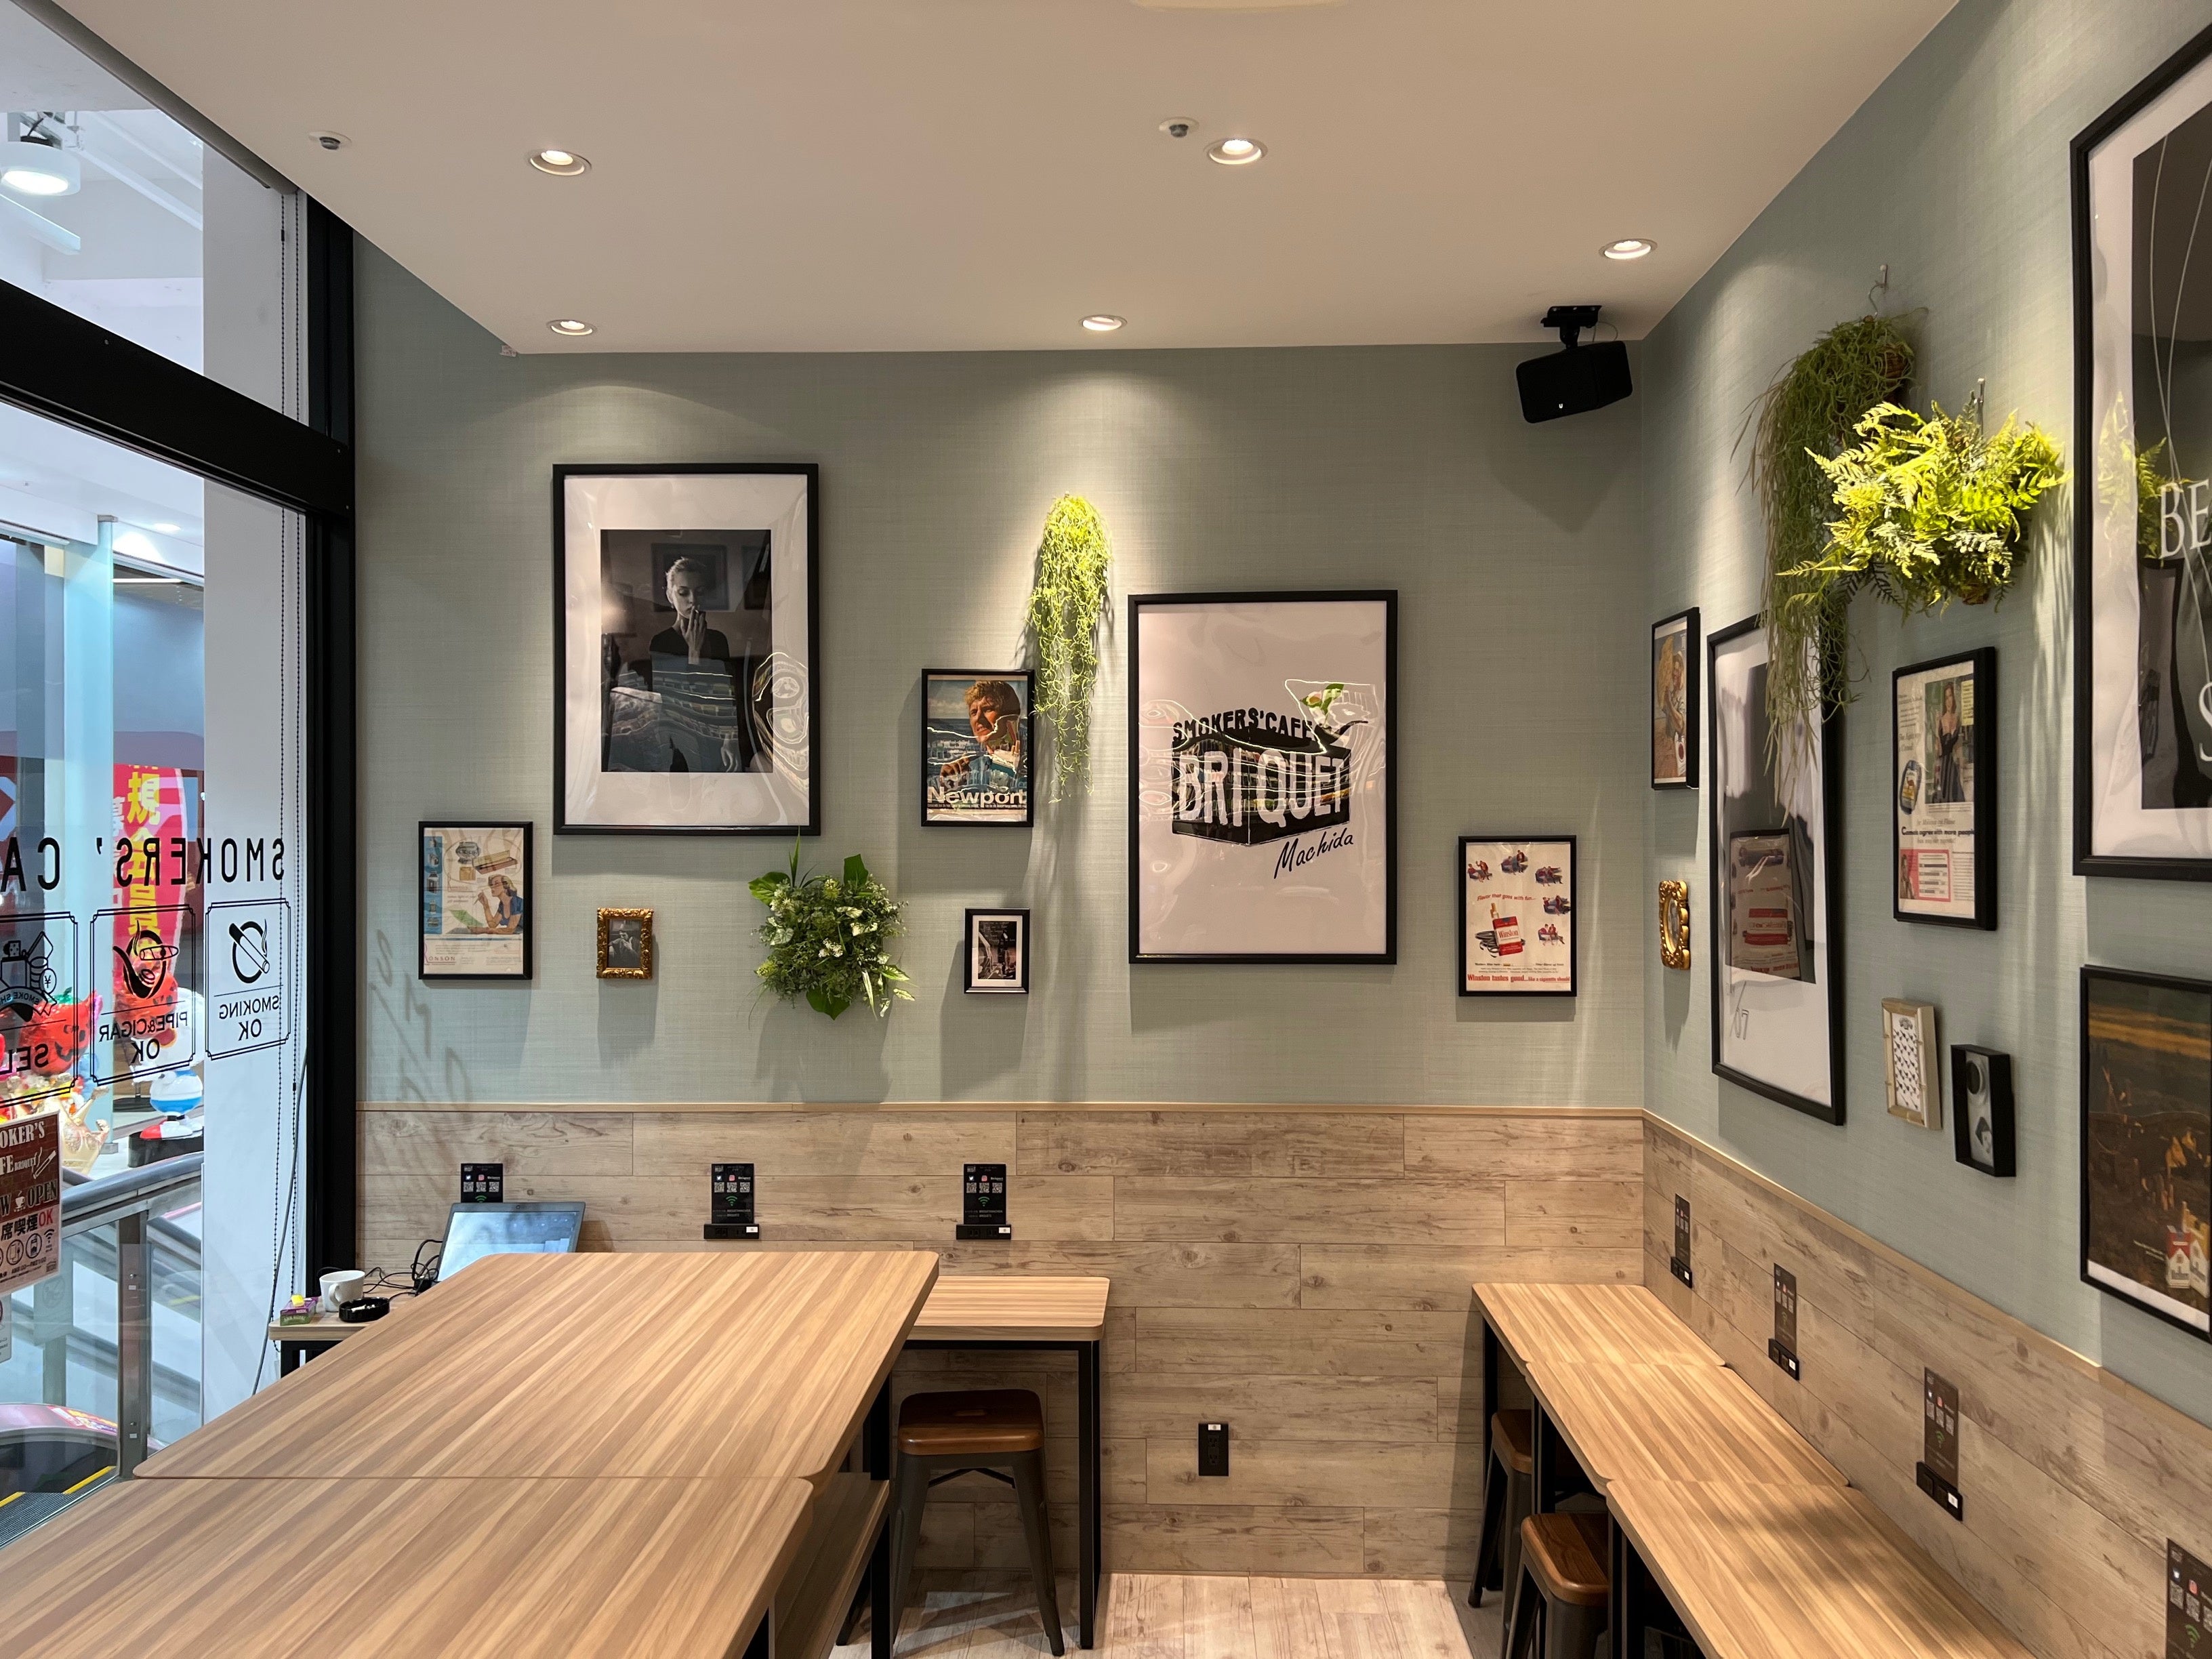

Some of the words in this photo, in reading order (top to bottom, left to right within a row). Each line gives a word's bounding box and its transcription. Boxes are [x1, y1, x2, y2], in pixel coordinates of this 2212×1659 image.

[927, 785, 1027, 808] Newport
[1273, 827, 1354, 879] Machida
[1498, 929, 1519, 939] Winston
[26, 1180, 58, 1208] OPEN
